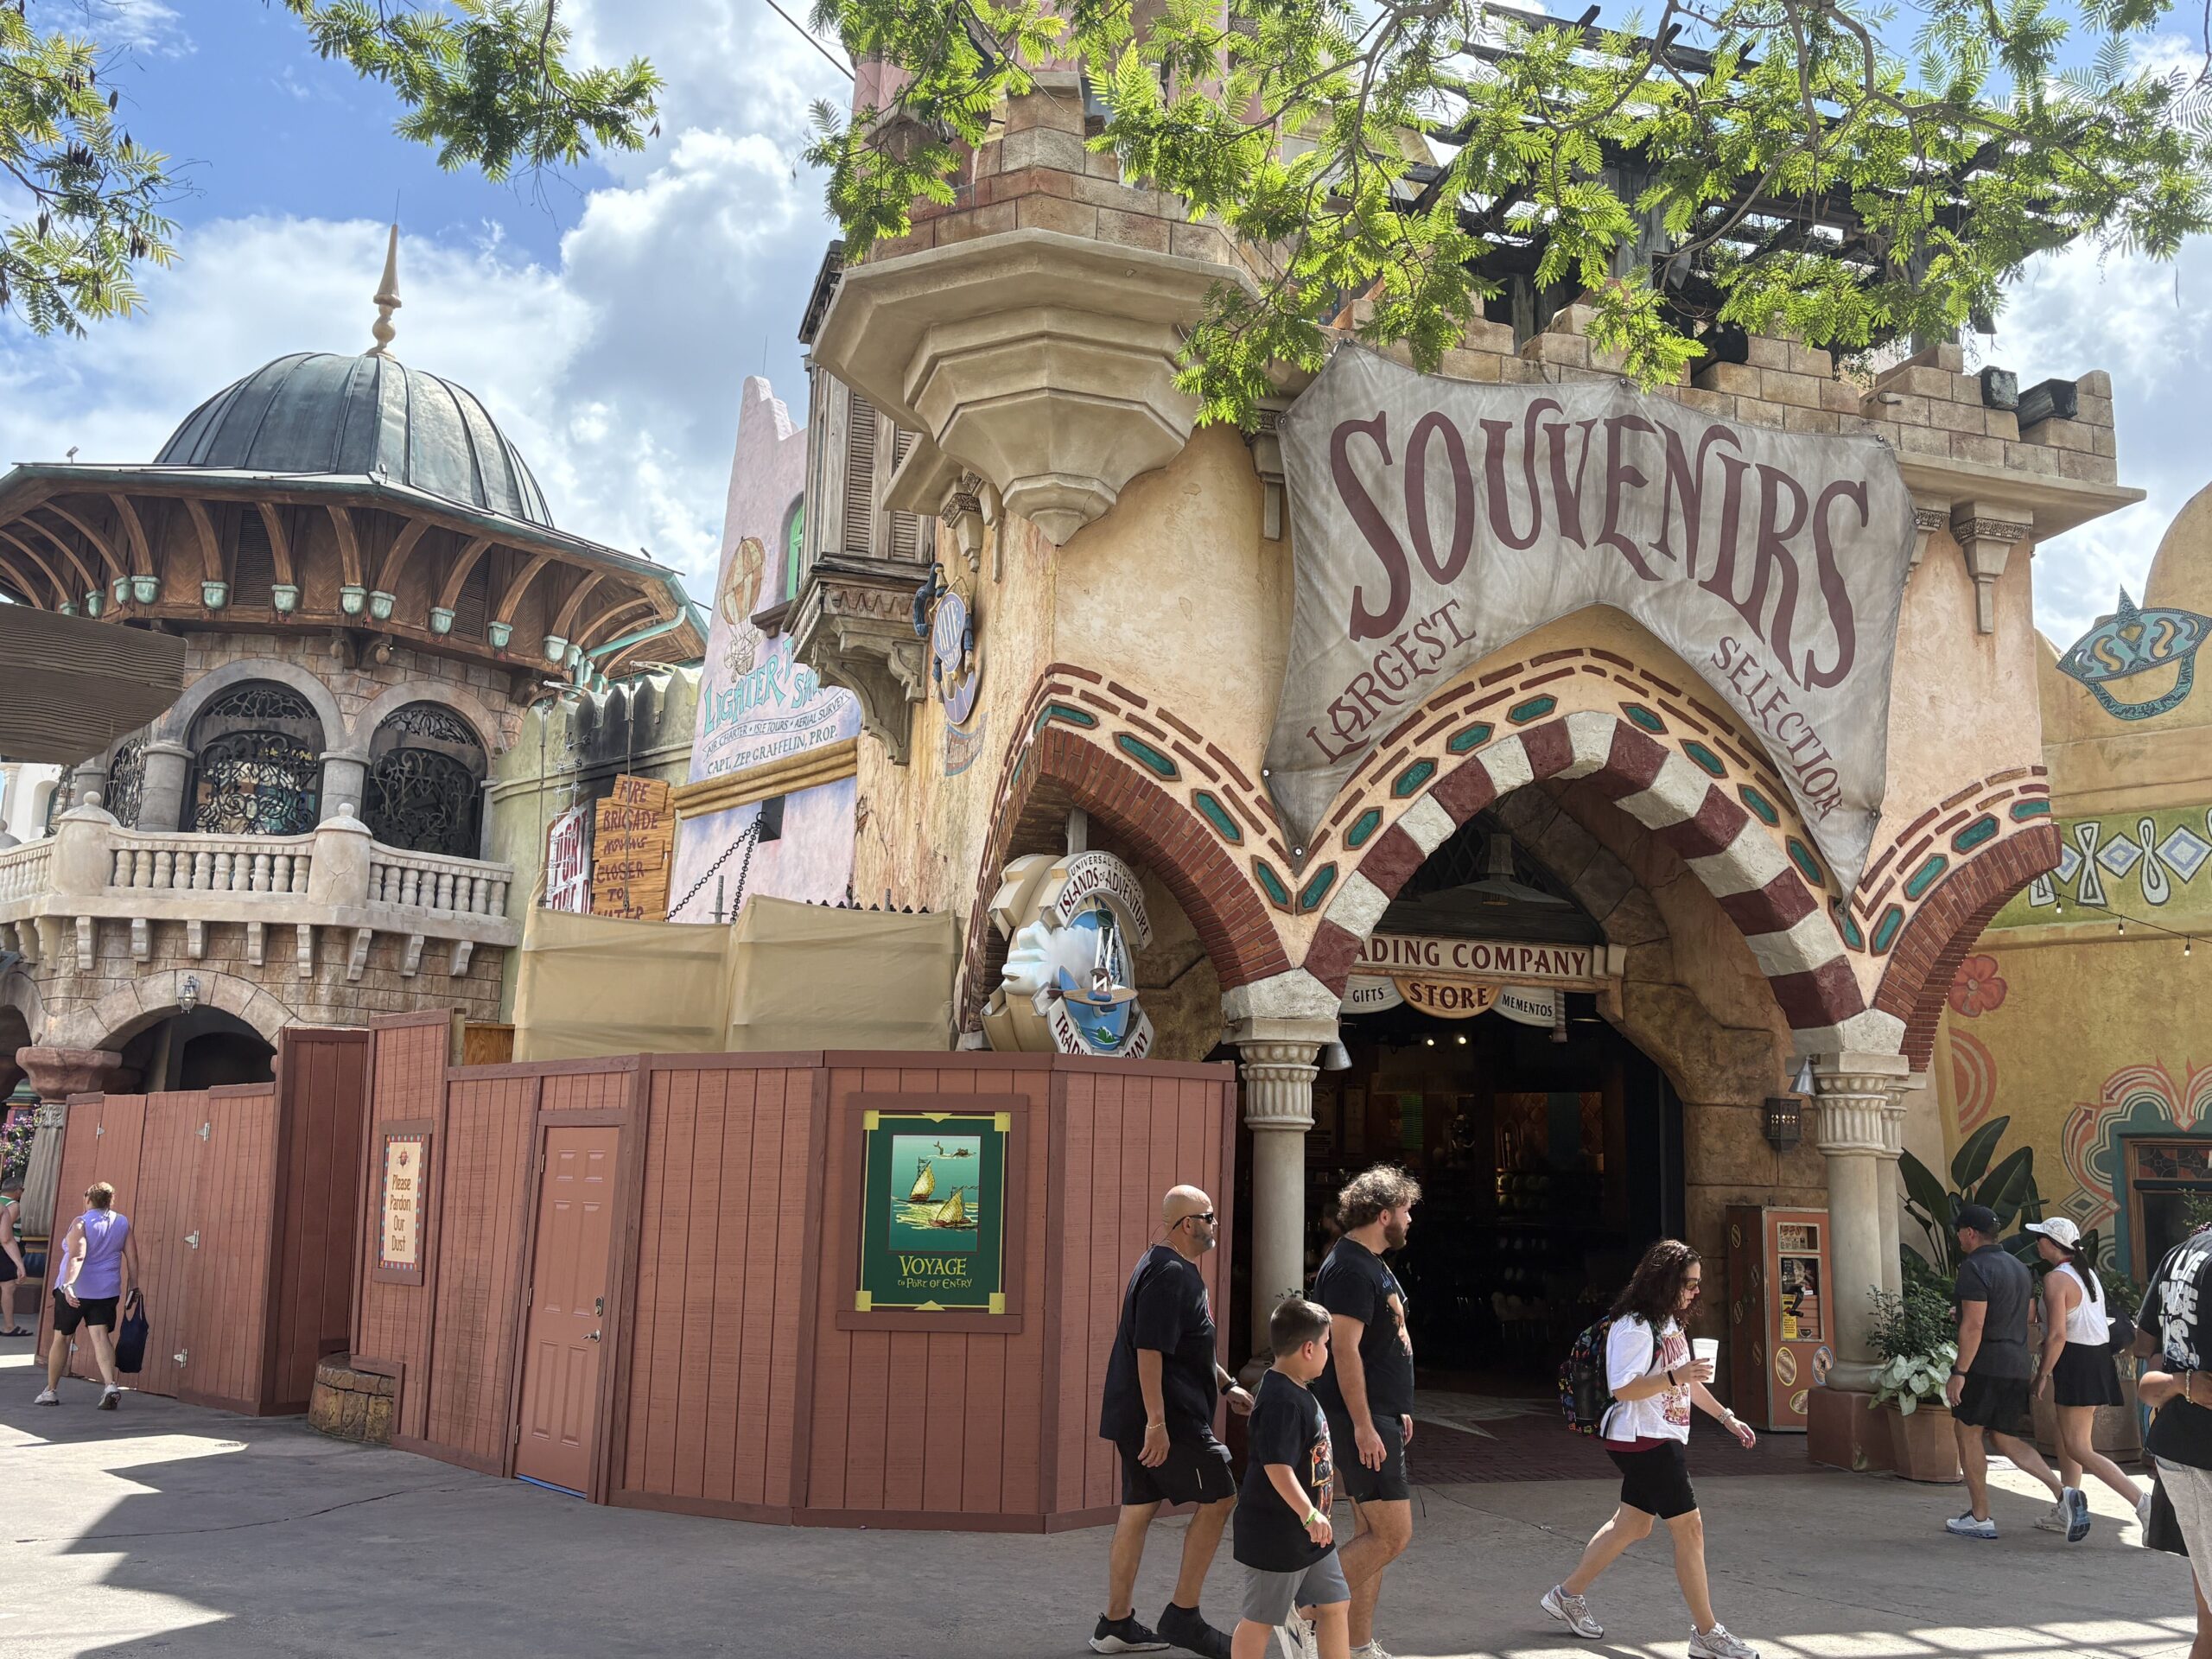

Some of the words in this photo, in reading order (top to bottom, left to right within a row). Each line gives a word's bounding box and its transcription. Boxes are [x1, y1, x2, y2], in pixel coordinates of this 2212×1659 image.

[1330, 397, 1869, 690] SOUVENIRS
[703, 637, 793, 739] LIGHTER-T
[1306, 599, 1477, 764] LARGEST
[707, 743, 717, 756] AIR
[720, 725, 747, 746] CHARTER
[753, 723, 766, 734] ISLE
[767, 721, 788, 734] TOURS
[795, 715, 817, 729] AERIAL
[818, 696, 845, 721] SURVEY
[810, 725, 838, 746] PROP.
[1711, 636, 1847, 823] SELECTION
[619, 780, 650, 804] FIRE
[603, 808, 659, 831] BRIGADE
[597, 861, 644, 884] CLOSER
[1071, 855, 1111, 876] UNIVERSAL
[607, 887, 624, 901] TO
[1059, 868, 1099, 918] ISLANDS
[1099, 871, 1106, 881] OF
[1105, 869, 1150, 940] ADVENTURE
[1358, 938, 1440, 967] ADING
[1452, 944, 1586, 976] COMPANY
[1352, 987, 1384, 1003] GIFTS
[1409, 982, 1489, 1009] STORE
[1502, 994, 1553, 1018] MEMENTOS
[1056, 1012, 1087, 1055] TRAD
[391, 1174, 411, 1191] Please
[390, 1194, 411, 1211] Pardon
[394, 1215, 405, 1231] Our
[391, 1235, 406, 1252] Dust
[899, 1255, 967, 1276] VOYAGE
